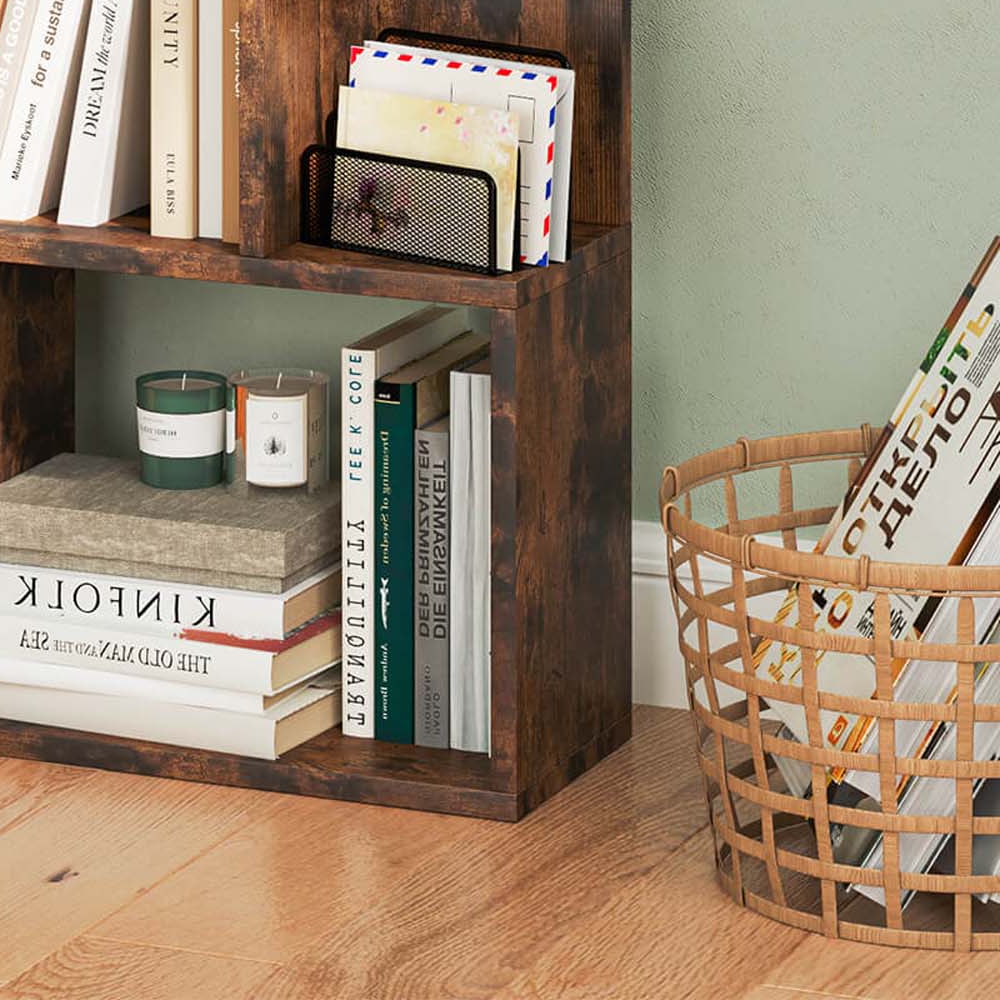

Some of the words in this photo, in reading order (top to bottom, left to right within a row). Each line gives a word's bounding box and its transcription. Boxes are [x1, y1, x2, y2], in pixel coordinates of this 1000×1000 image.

[102, 4, 118, 43] world
[2, 52, 15, 66] A
[31, 64, 48, 88] for
[41, 49, 52, 61] a
[97, 42, 111, 67] the
[83, 67, 108, 138] DREAM
[878, 387, 972, 550] ДЕЛО
